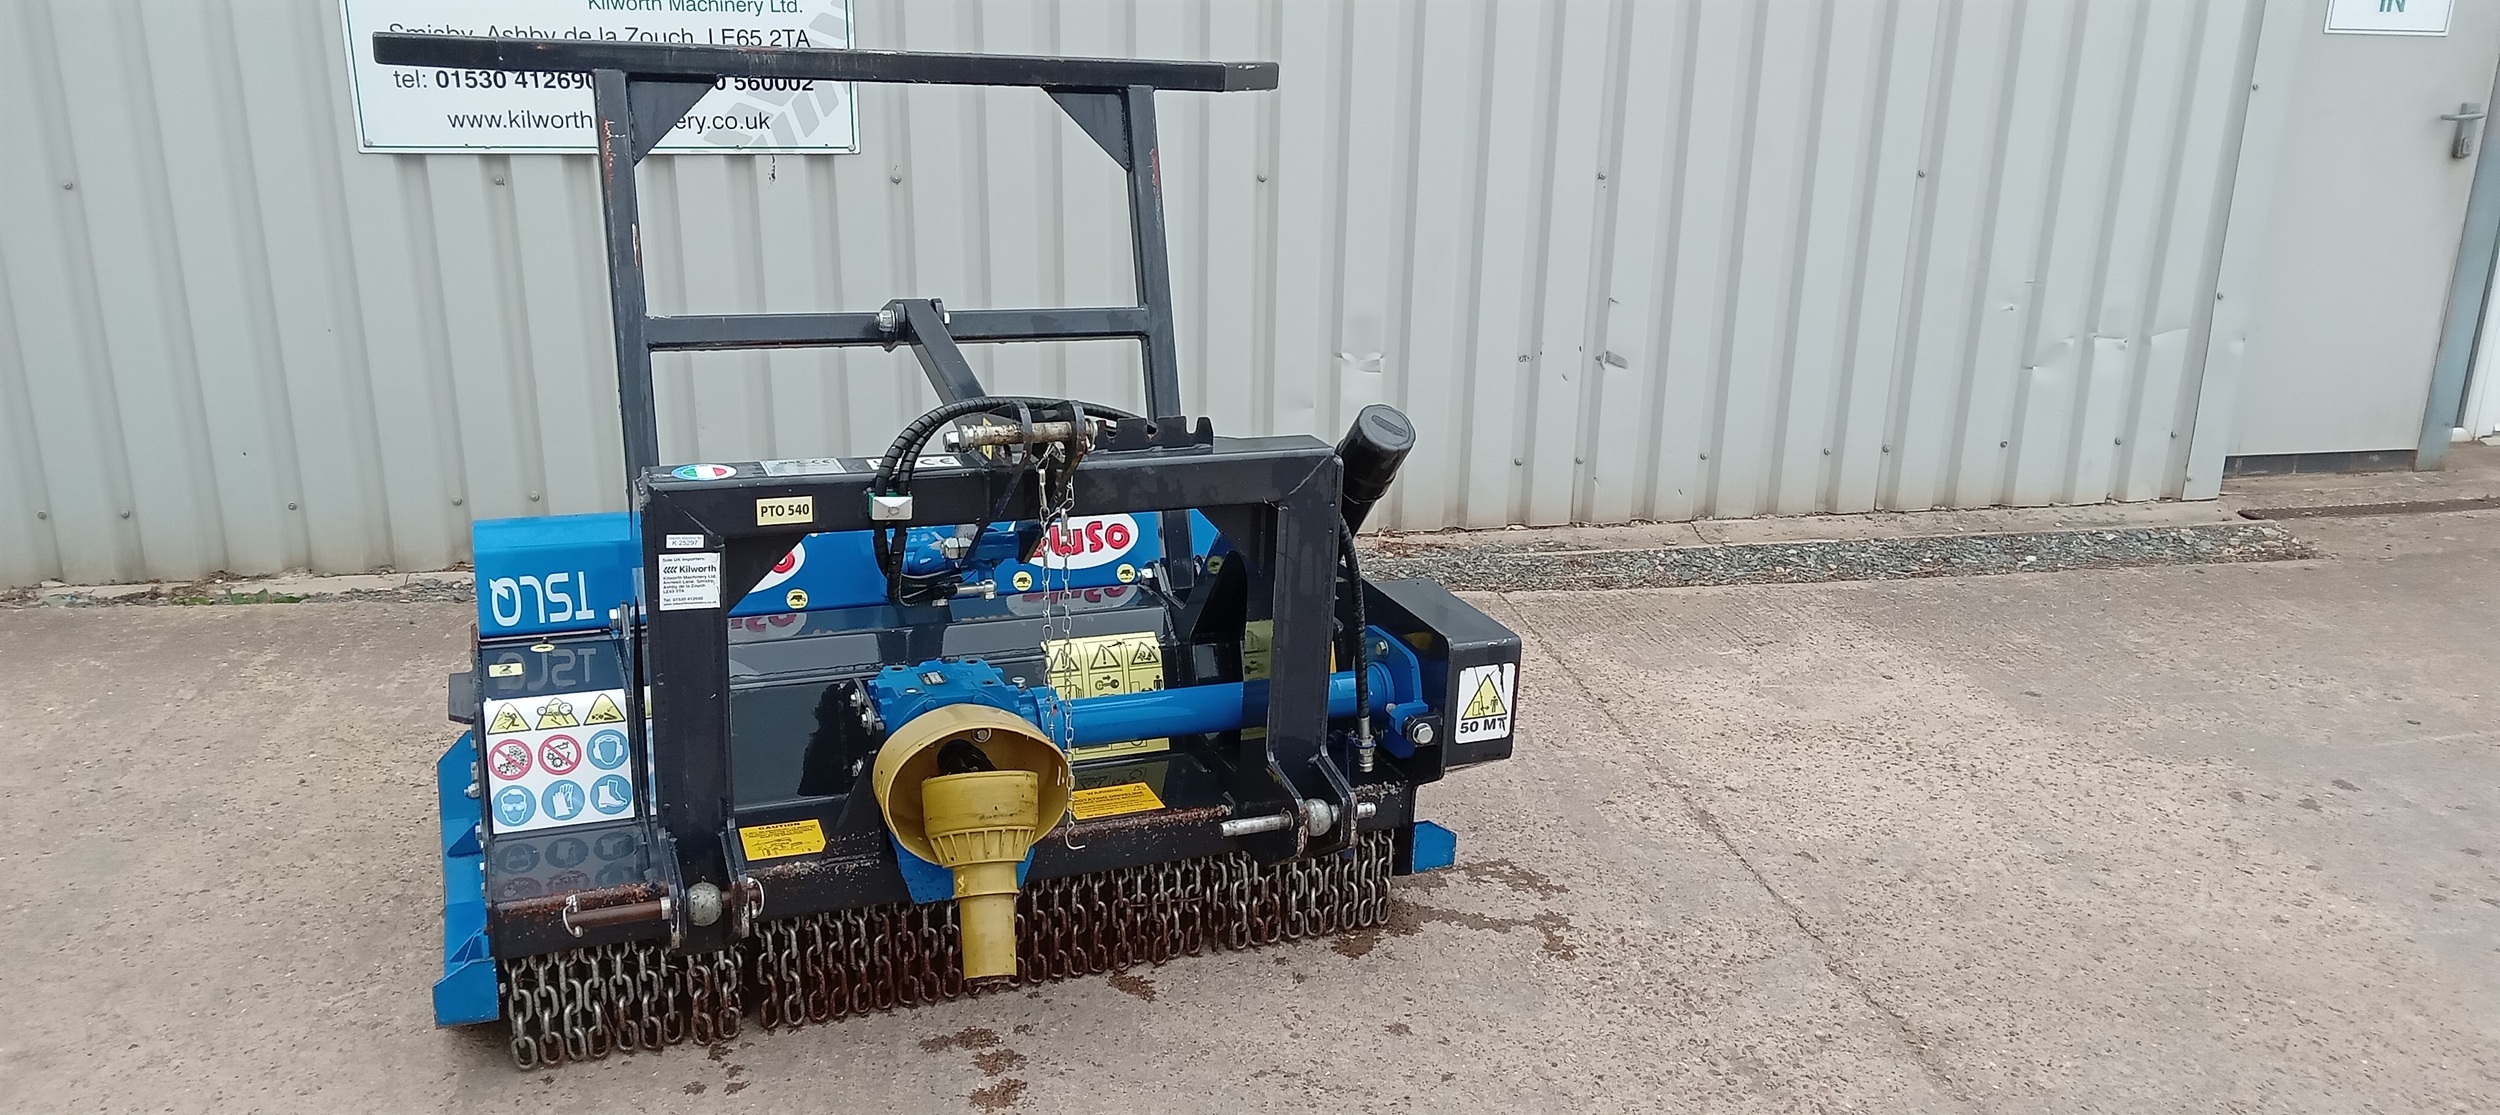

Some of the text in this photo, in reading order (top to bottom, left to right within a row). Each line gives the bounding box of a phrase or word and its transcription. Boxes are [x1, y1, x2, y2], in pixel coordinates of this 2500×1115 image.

[589, 0, 803, 16] Kilworth Machinery Ltd.
[564, 26, 592, 40] de
[599, 26, 617, 41] la
[770, 29, 811, 48] 2TA
[393, 69, 428, 89] tel:
[435, 70, 507, 89] 01530
[760, 503, 810, 518] PTO 540
[679, 564, 717, 573] Kilworth
[1460, 720, 1479, 734] 50
[758, 822, 801, 831] CAUTION
